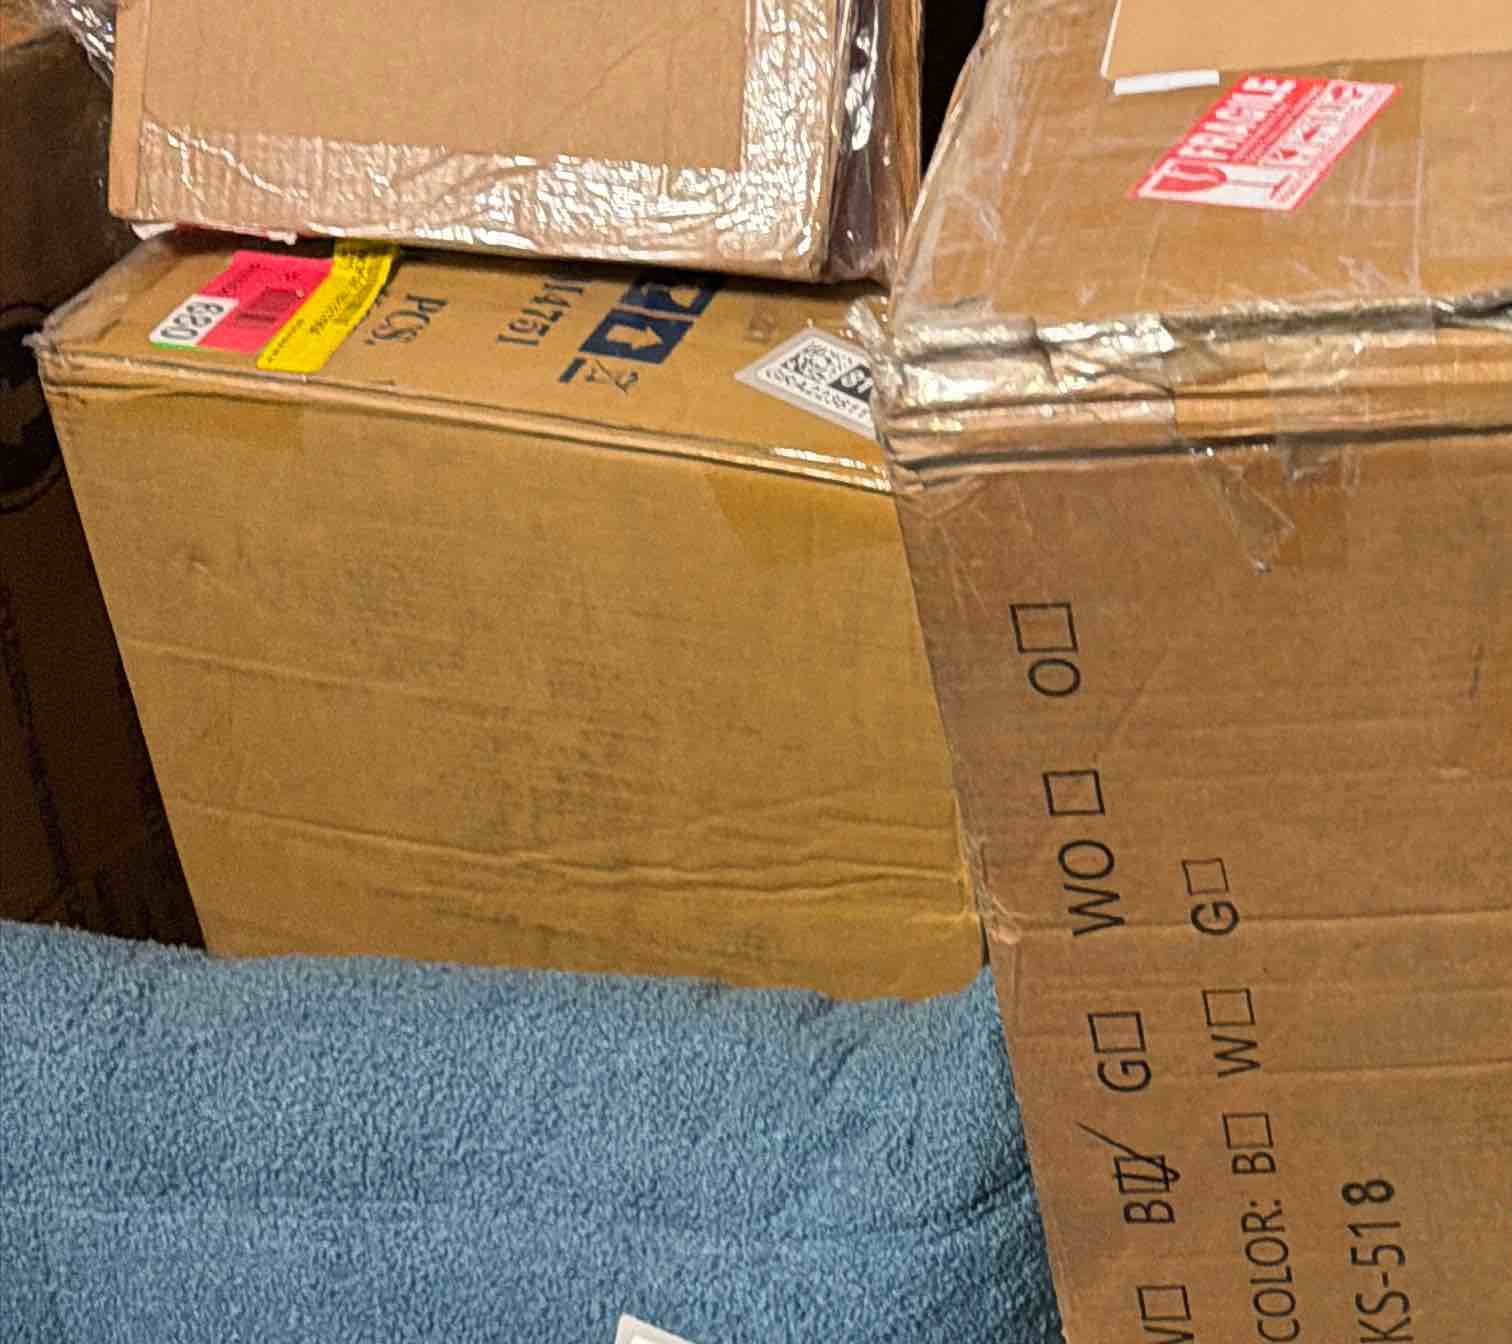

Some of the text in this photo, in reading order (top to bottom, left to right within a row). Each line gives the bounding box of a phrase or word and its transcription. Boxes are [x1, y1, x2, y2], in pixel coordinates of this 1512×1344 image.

[1058, 839, 1126, 937] WO
[1190, 900, 1240, 936] G
[1211, 1034, 1262, 1078] W
[1097, 1060, 1152, 1092] G
[1231, 1152, 1276, 1175] B
[1124, 1200, 1176, 1224] B
[1241, 1198, 1300, 1344] COLOR:
